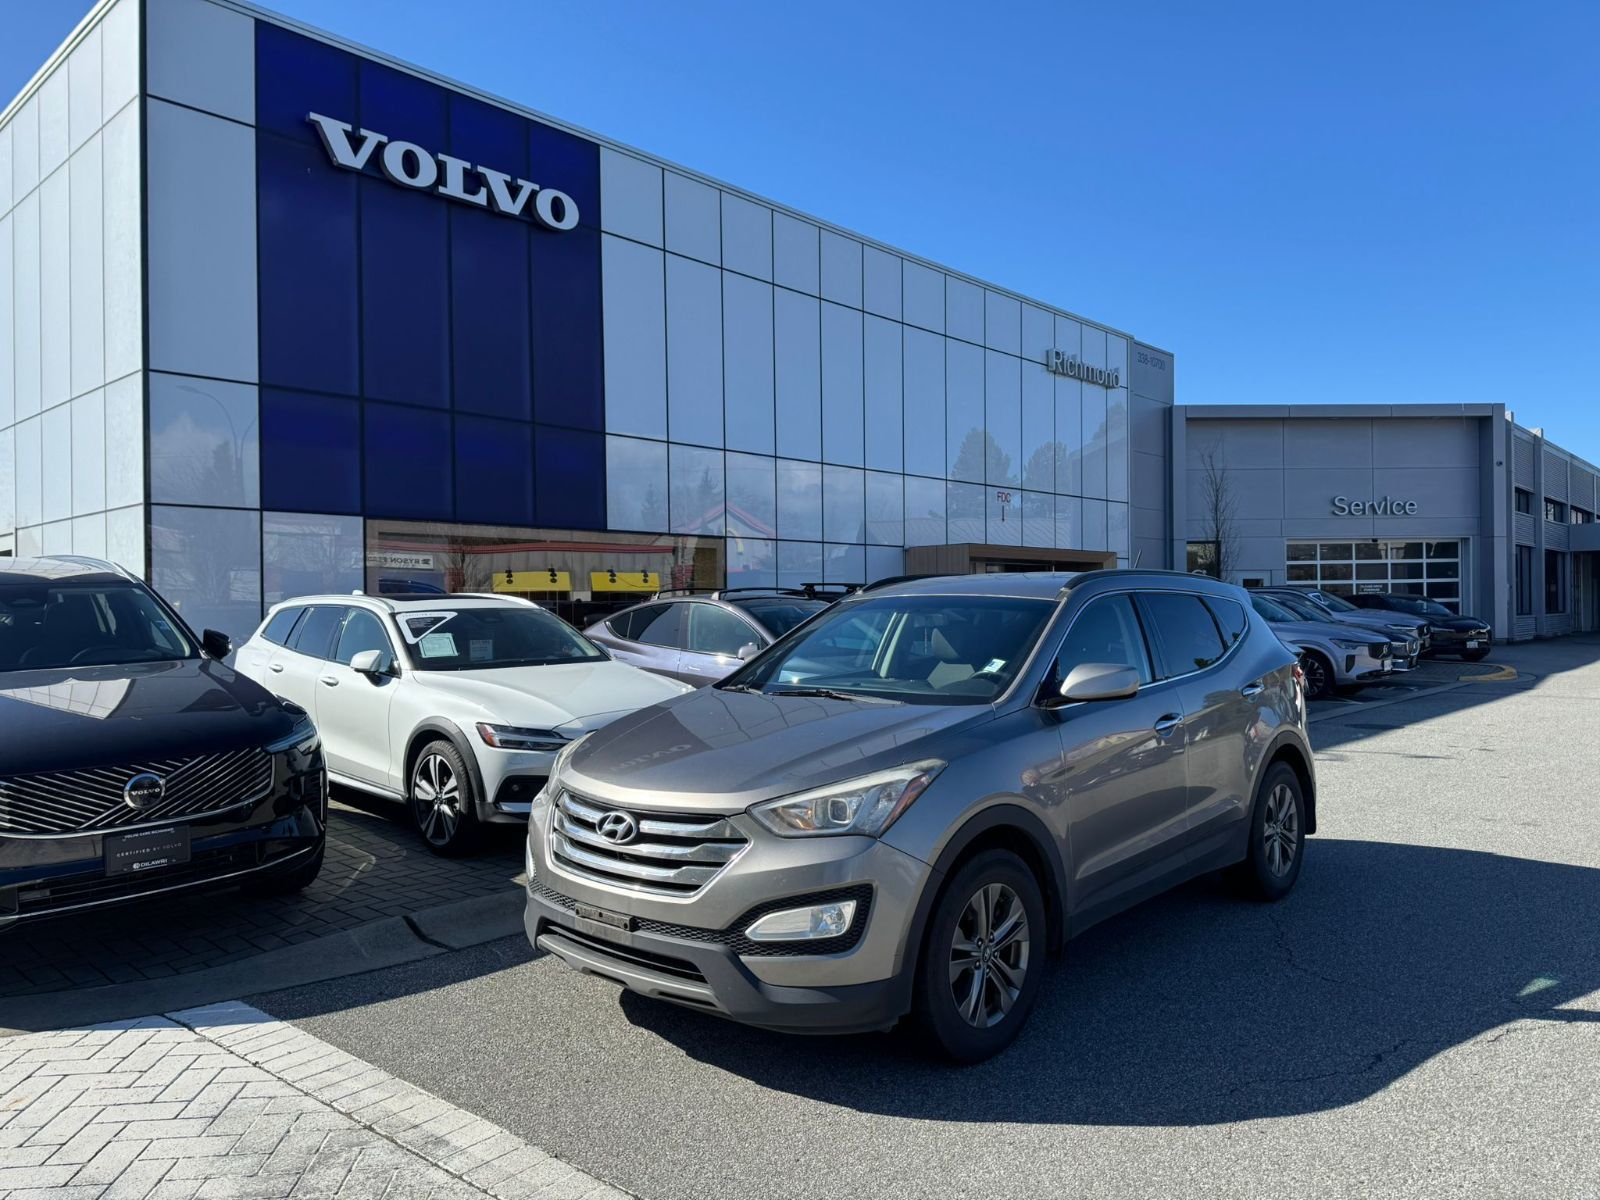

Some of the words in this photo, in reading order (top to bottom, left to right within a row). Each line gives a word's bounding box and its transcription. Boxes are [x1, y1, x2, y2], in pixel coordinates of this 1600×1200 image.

[306, 111, 580, 232] VOLVO
[1047, 347, 1120, 388] Richmond
[1333, 495, 1418, 516] Service
[116, 847, 150, 858] CERTIFIED
[140, 858, 168, 867] DILAWRI
